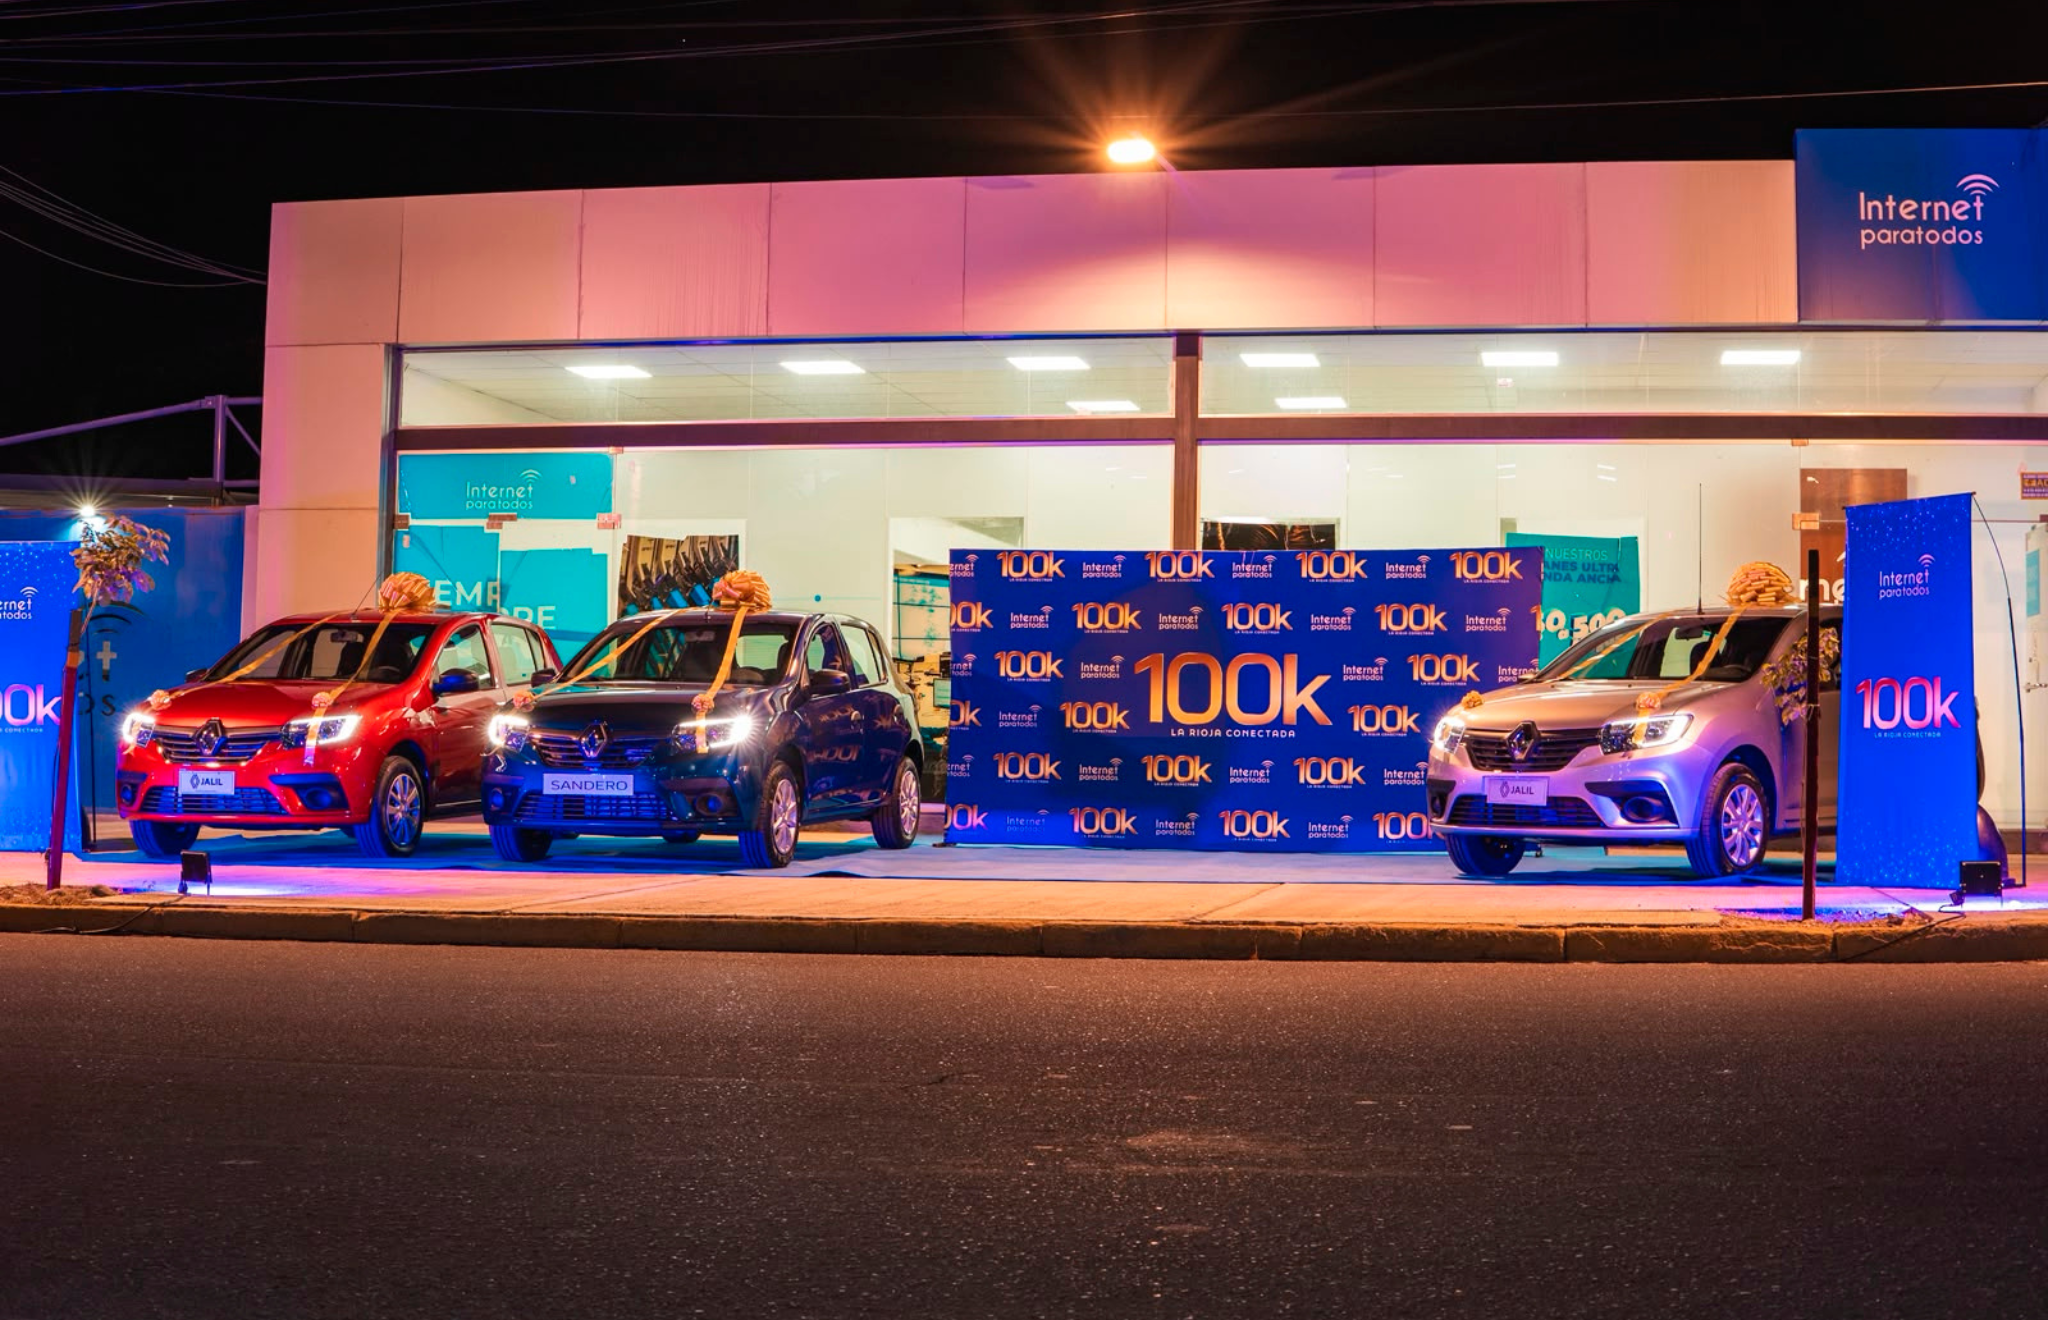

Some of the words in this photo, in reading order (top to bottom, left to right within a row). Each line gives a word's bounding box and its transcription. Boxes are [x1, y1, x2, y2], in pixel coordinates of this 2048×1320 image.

[1859, 191, 1984, 221] Internet
[1860, 226, 1983, 250] paratodos
[466, 482, 533, 498] Internet
[466, 498, 533, 510] paratodos
[1546, 549, 1608, 560] NUESTROS
[997, 551, 1065, 578] 100k
[1083, 562, 1122, 572] Internet
[1144, 551, 1215, 578] 100k
[1232, 562, 1272, 572] Internet
[1295, 551, 1368, 579] 100k
[1386, 562, 1426, 572] Internet
[1449, 551, 1523, 580] 100k
[1879, 569, 1930, 586] Internet
[1879, 586, 1930, 600] paratodos
[0, 610, 32, 620] todos
[1011, 612, 1049, 622] Internet
[1071, 602, 1142, 629] 100k
[1159, 613, 1198, 623] Internet
[1221, 602, 1293, 631] 100k
[1310, 614, 1351, 624] Internet
[1374, 603, 1448, 631] 100k
[1466, 615, 1507, 625] Internet
[994, 650, 1064, 678] 100k
[1080, 662, 1120, 672] Internet
[1343, 664, 1384, 674] Internet
[1407, 653, 1480, 682] 100k
[1134, 652, 1333, 725] 100k
[0, 684, 62, 726] 0k
[1856, 676, 1961, 730] 100k
[999, 711, 1037, 721] Internet
[1059, 701, 1130, 729] 100k
[1347, 704, 1421, 733] 100k
[1171, 729, 1184, 737] LA
[1189, 729, 1222, 737] RIOJA
[1225, 729, 1295, 738] CONECTADA
[993, 752, 1062, 780] 100k
[1079, 764, 1118, 775] Internet
[1141, 754, 1212, 783] 100k
[1230, 766, 1270, 777] Internet
[1293, 757, 1366, 785] 100k
[1384, 768, 1425, 778] Internet
[200, 778, 223, 786] JALIL
[551, 780, 628, 791] SANDERO
[1511, 786, 1534, 795] JALIL
[1069, 807, 1138, 835] 100k
[1156, 818, 1195, 829] Internet
[1218, 809, 1290, 838] 100k
[1308, 821, 1349, 832] Internet
